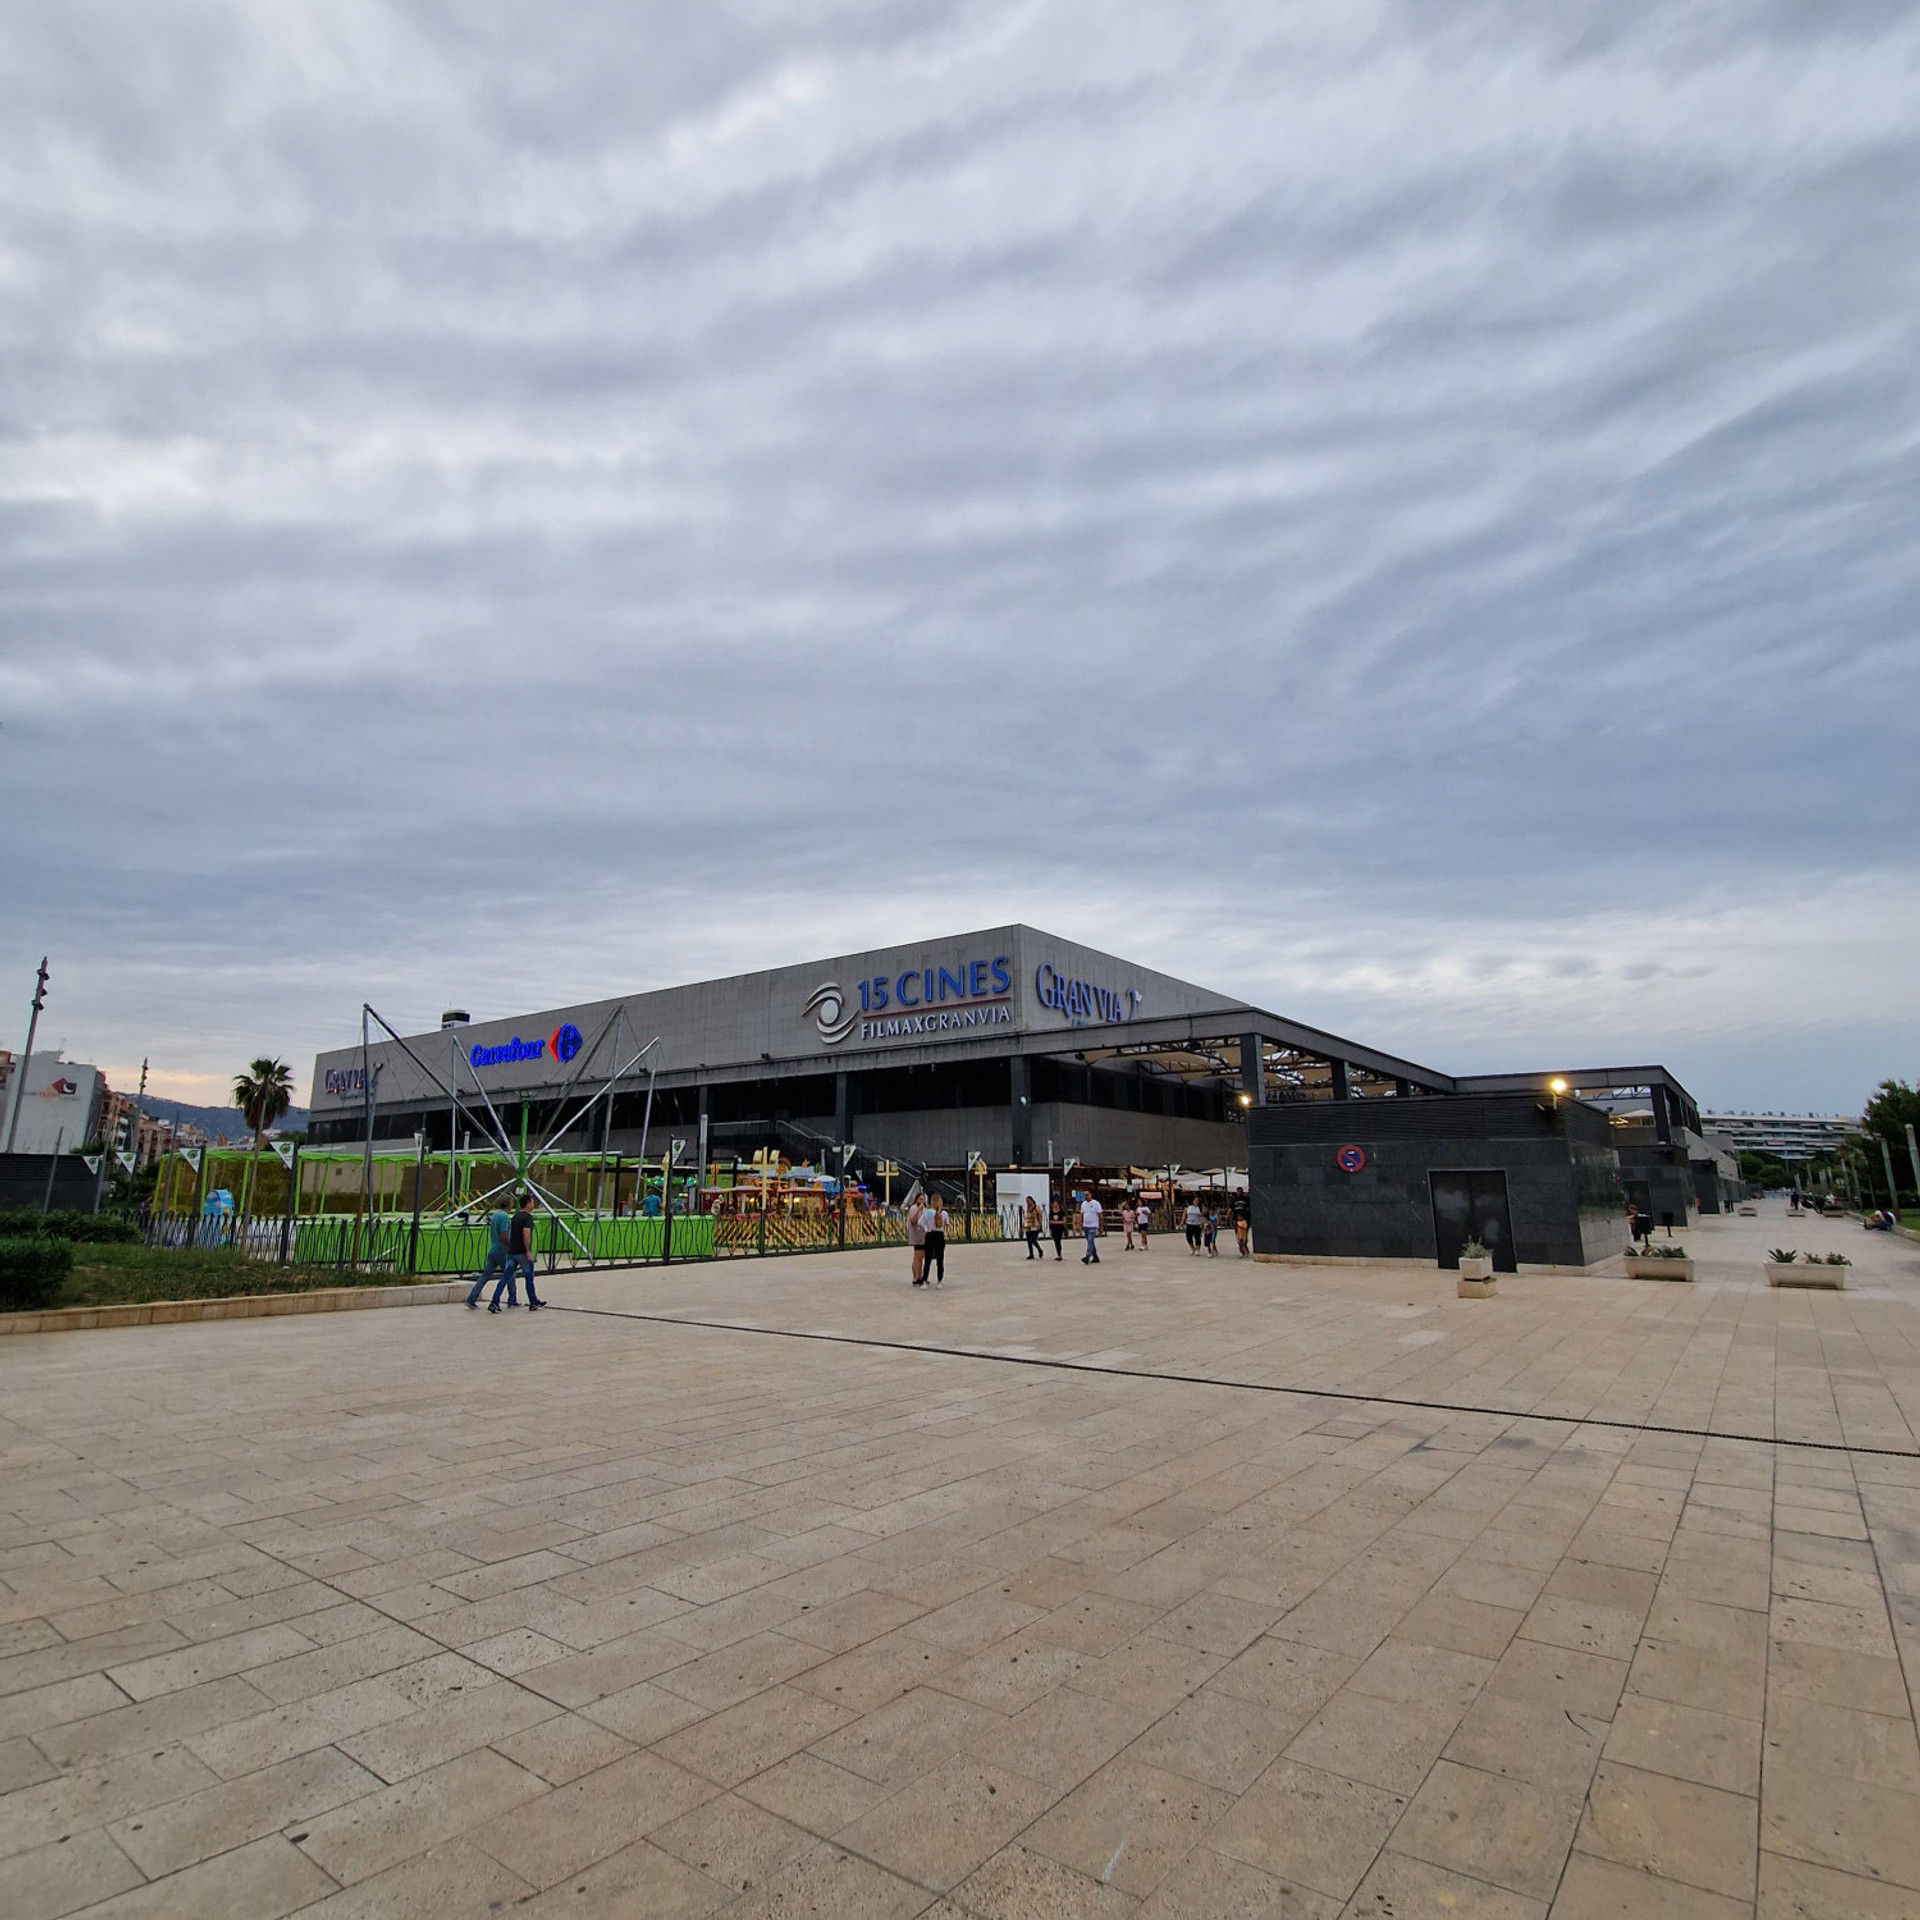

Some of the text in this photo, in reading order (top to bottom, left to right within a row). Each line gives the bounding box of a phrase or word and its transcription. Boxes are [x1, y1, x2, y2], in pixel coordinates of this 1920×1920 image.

[857, 956, 1011, 1011] 15 CINES
[1036, 962, 1093, 1018] GRAN
[1093, 986, 1123, 1022] VIA
[470, 1036, 545, 1067] Carrefour
